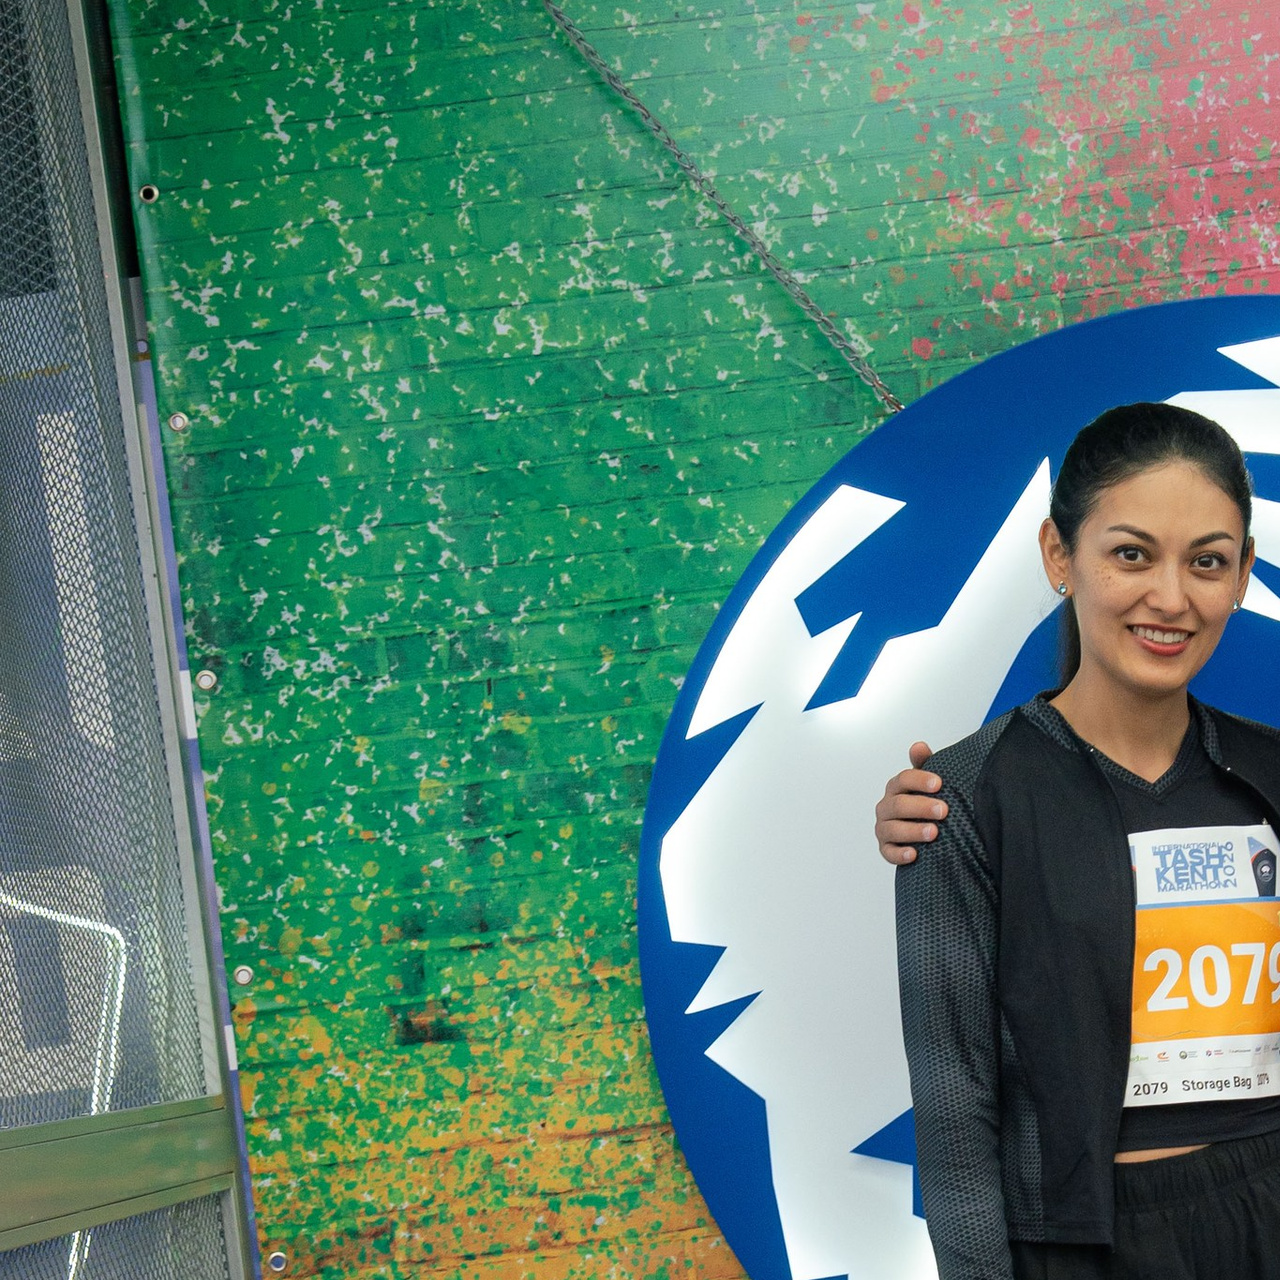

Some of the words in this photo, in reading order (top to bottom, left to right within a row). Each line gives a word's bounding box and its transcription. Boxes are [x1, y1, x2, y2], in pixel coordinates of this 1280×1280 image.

[1152, 841, 1220, 852] INTERNATIONAL
[1153, 847, 1224, 870] TASH
[1222, 841, 1238, 888] 2026
[1155, 864, 1224, 888] KENT
[1158, 880, 1229, 892] MARATHON
[1132, 1081, 1169, 1097] 2079
[1181, 1078, 1231, 1092] Storage
[1233, 1076, 1252, 1090] Bag
[1256, 1072, 1270, 1086] 2079
